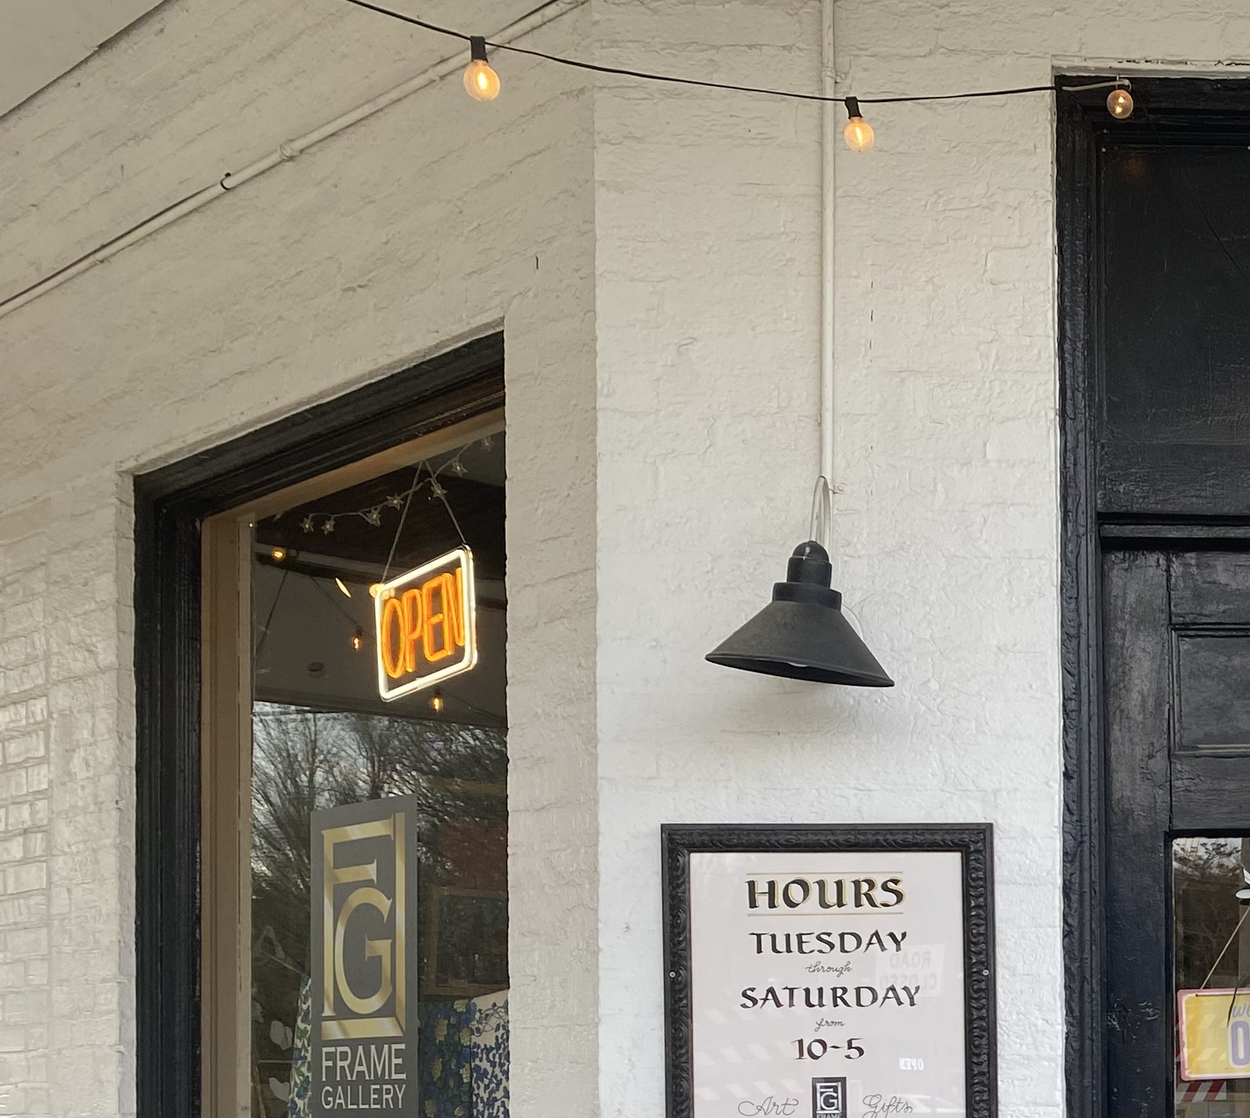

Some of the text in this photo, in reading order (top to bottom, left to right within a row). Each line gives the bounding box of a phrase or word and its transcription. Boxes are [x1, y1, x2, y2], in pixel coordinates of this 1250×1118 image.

[379, 567, 465, 679] OPEN
[744, 876, 907, 910] HOURS
[748, 929, 907, 955] TUESDAY
[805, 961, 852, 977] through
[739, 984, 921, 1010] SATURDAY
[814, 1018, 845, 1032] from
[790, 1038, 865, 1061] 10-5
[321, 1043, 407, 1083] FRAME
[321, 1084, 407, 1110] GALLERY
[737, 1096, 799, 1117] Art
